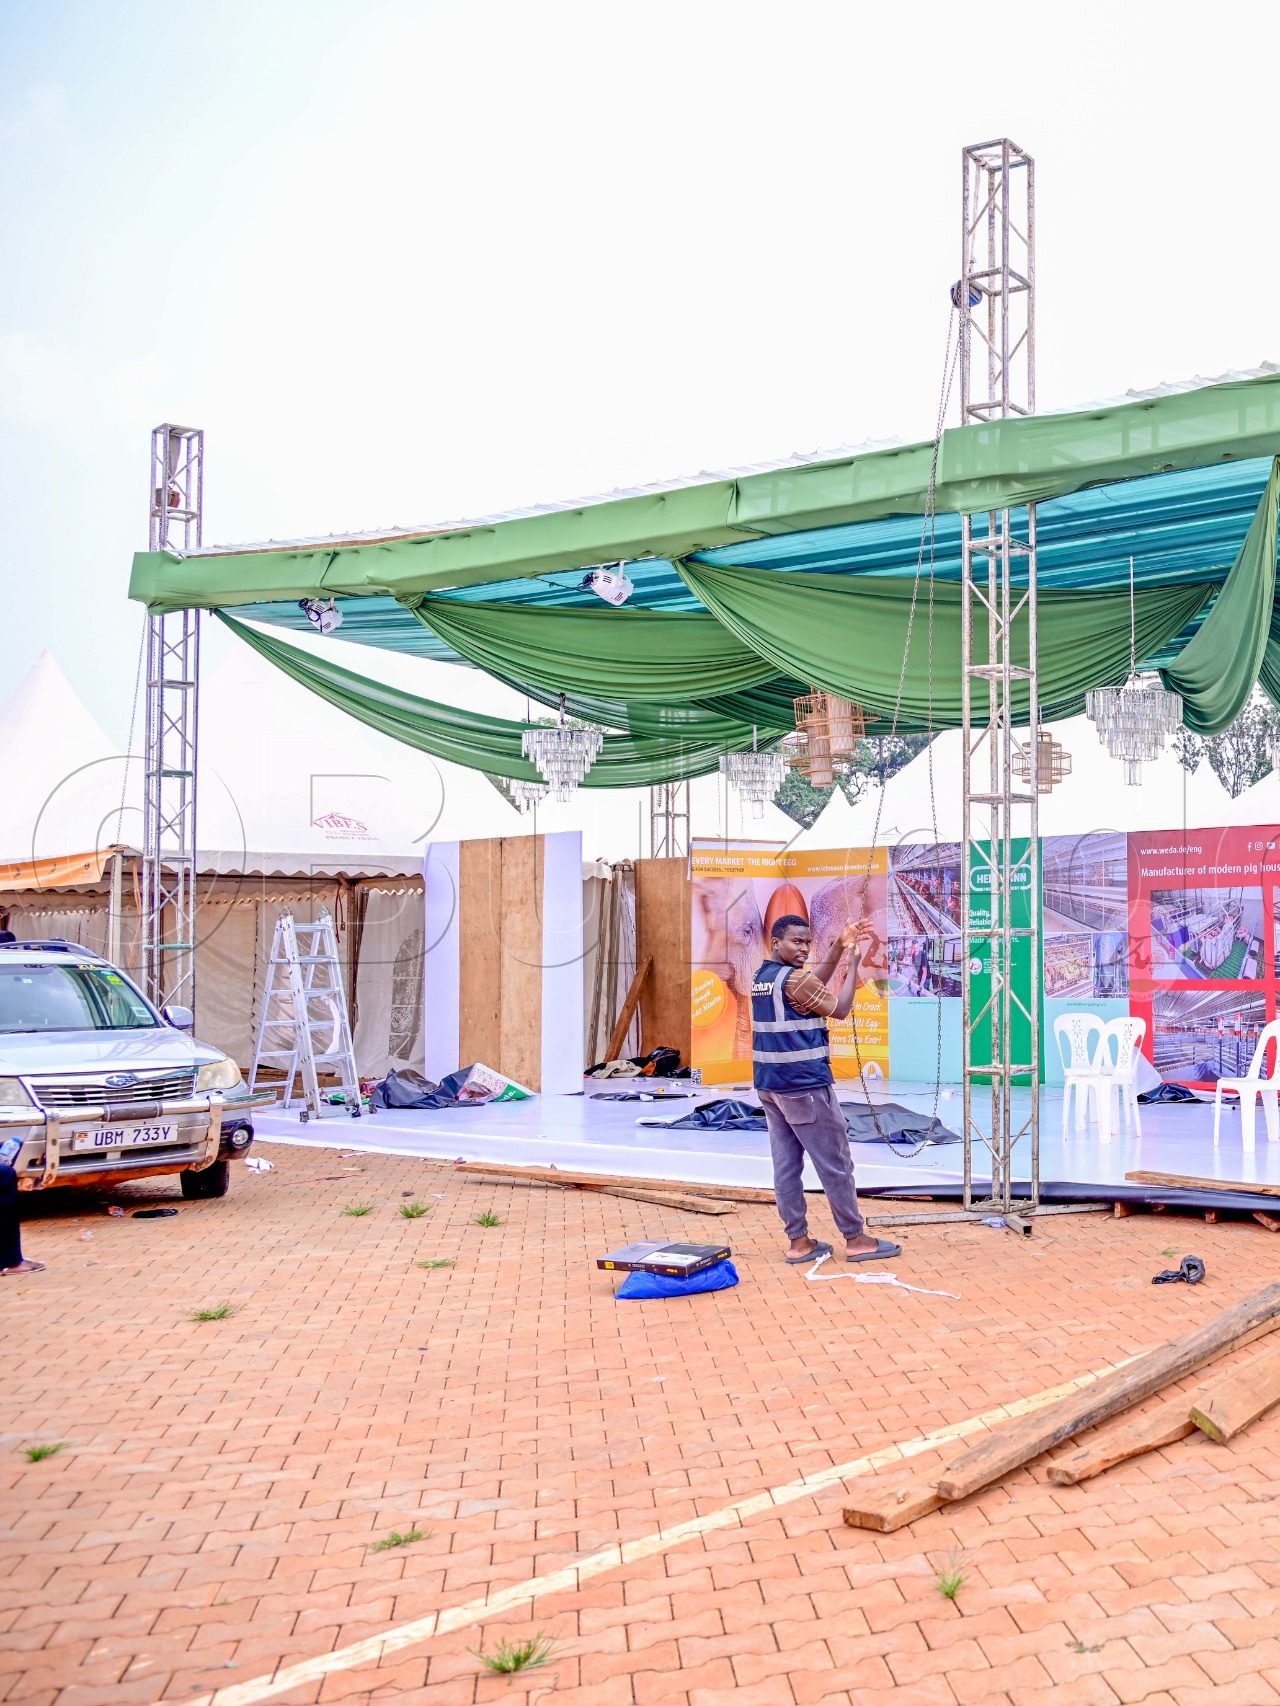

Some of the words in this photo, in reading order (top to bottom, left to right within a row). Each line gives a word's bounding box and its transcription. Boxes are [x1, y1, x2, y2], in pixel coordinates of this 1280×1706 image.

[313, 819, 367, 831] VIBES
[1140, 845, 1202, 855] www.weda.de/eng
[692, 857, 713, 865] EVERY
[715, 857, 744, 866] MARKET
[747, 858, 761, 866] THE
[762, 858, 782, 866] RIGHT
[783, 858, 797, 866] EGG
[1141, 866, 1195, 877] Manufacturer
[1198, 865, 1207, 874] of
[1208, 863, 1242, 874] modern
[1244, 863, 1258, 875] pig
[863, 1001, 881, 1011] Crack
[831, 1034, 847, 1043] More
[865, 1034, 882, 1044] Ever!
[94, 1130, 124, 1146] UBM
[132, 1126, 171, 1143] 733Y
